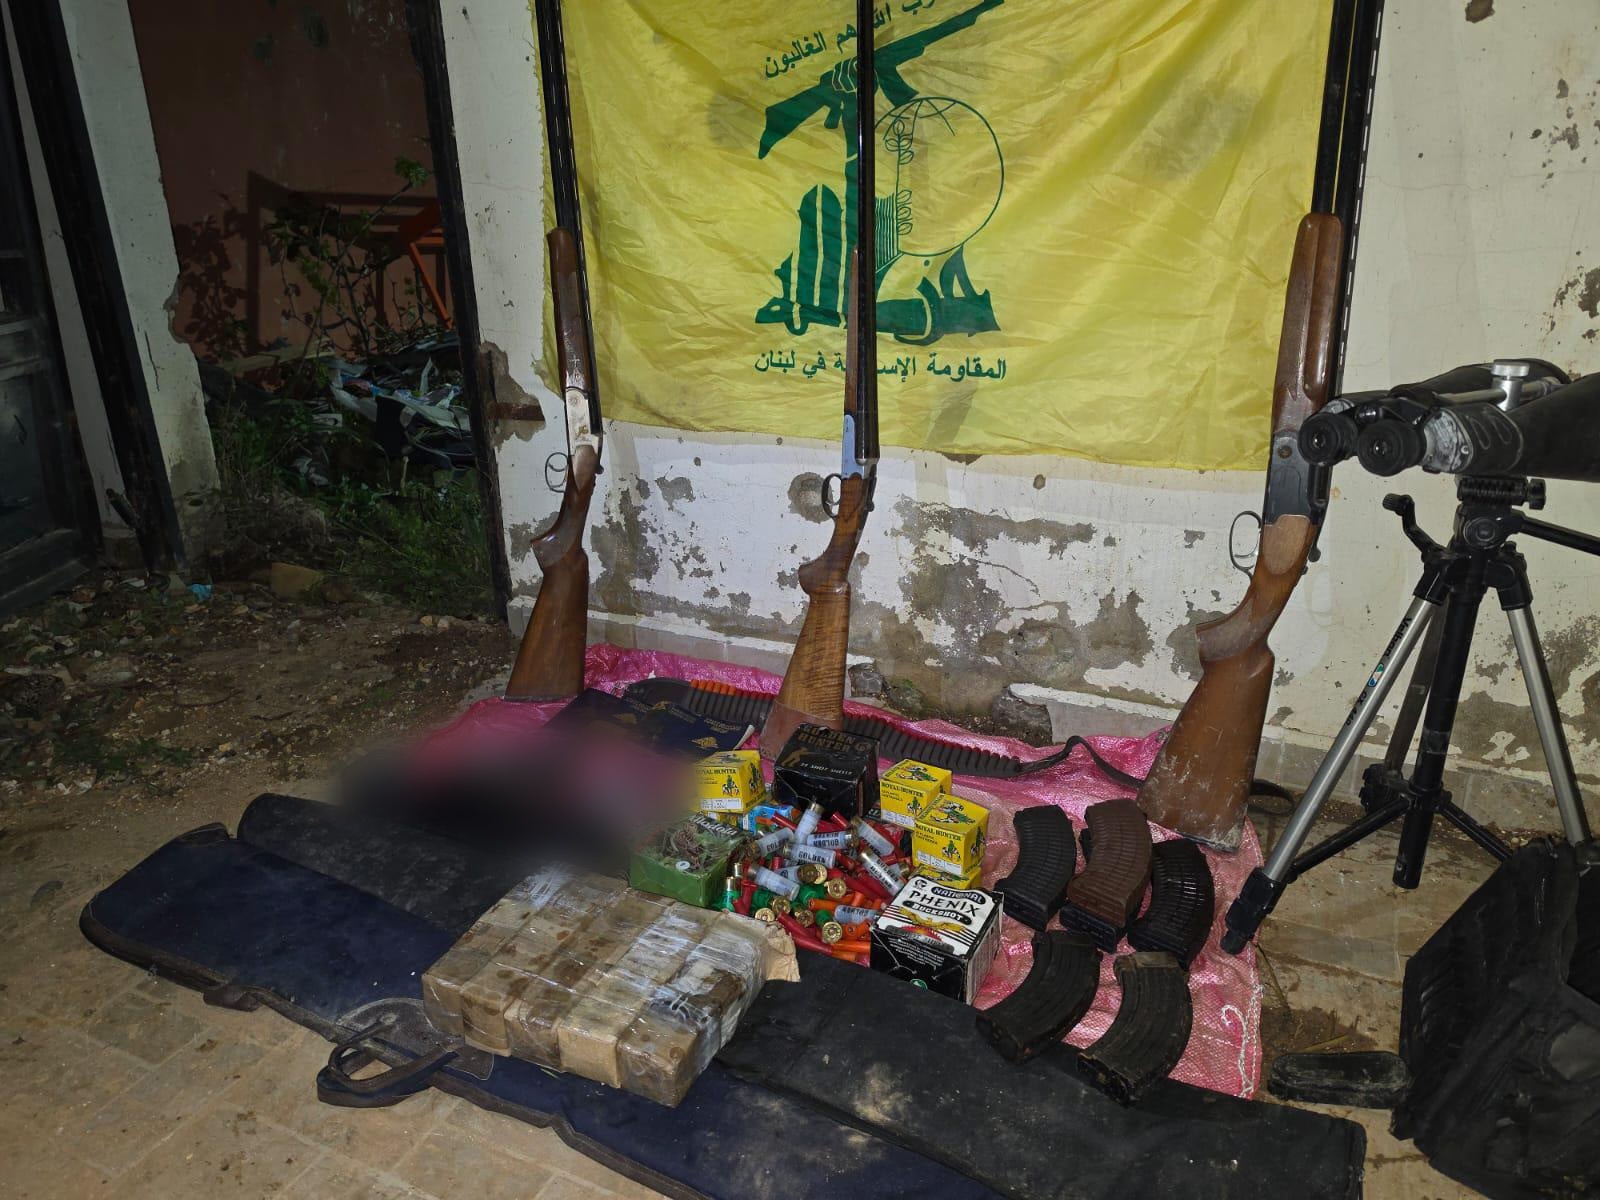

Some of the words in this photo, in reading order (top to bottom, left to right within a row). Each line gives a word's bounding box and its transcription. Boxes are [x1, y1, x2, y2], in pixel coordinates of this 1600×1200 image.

[765, 30, 827, 79] الغالبون
[754, 350, 796, 373] لبنان
[802, 352, 826, 379] في
[926, 352, 1007, 382] المقاومة
[1384, 617, 1412, 658] Velbon
[798, 851, 826, 863] GOLDEN
[908, 890, 980, 917] PHENIX
[933, 887, 984, 903] NATIONAL
[911, 902, 964, 921] BUCKSHOT
